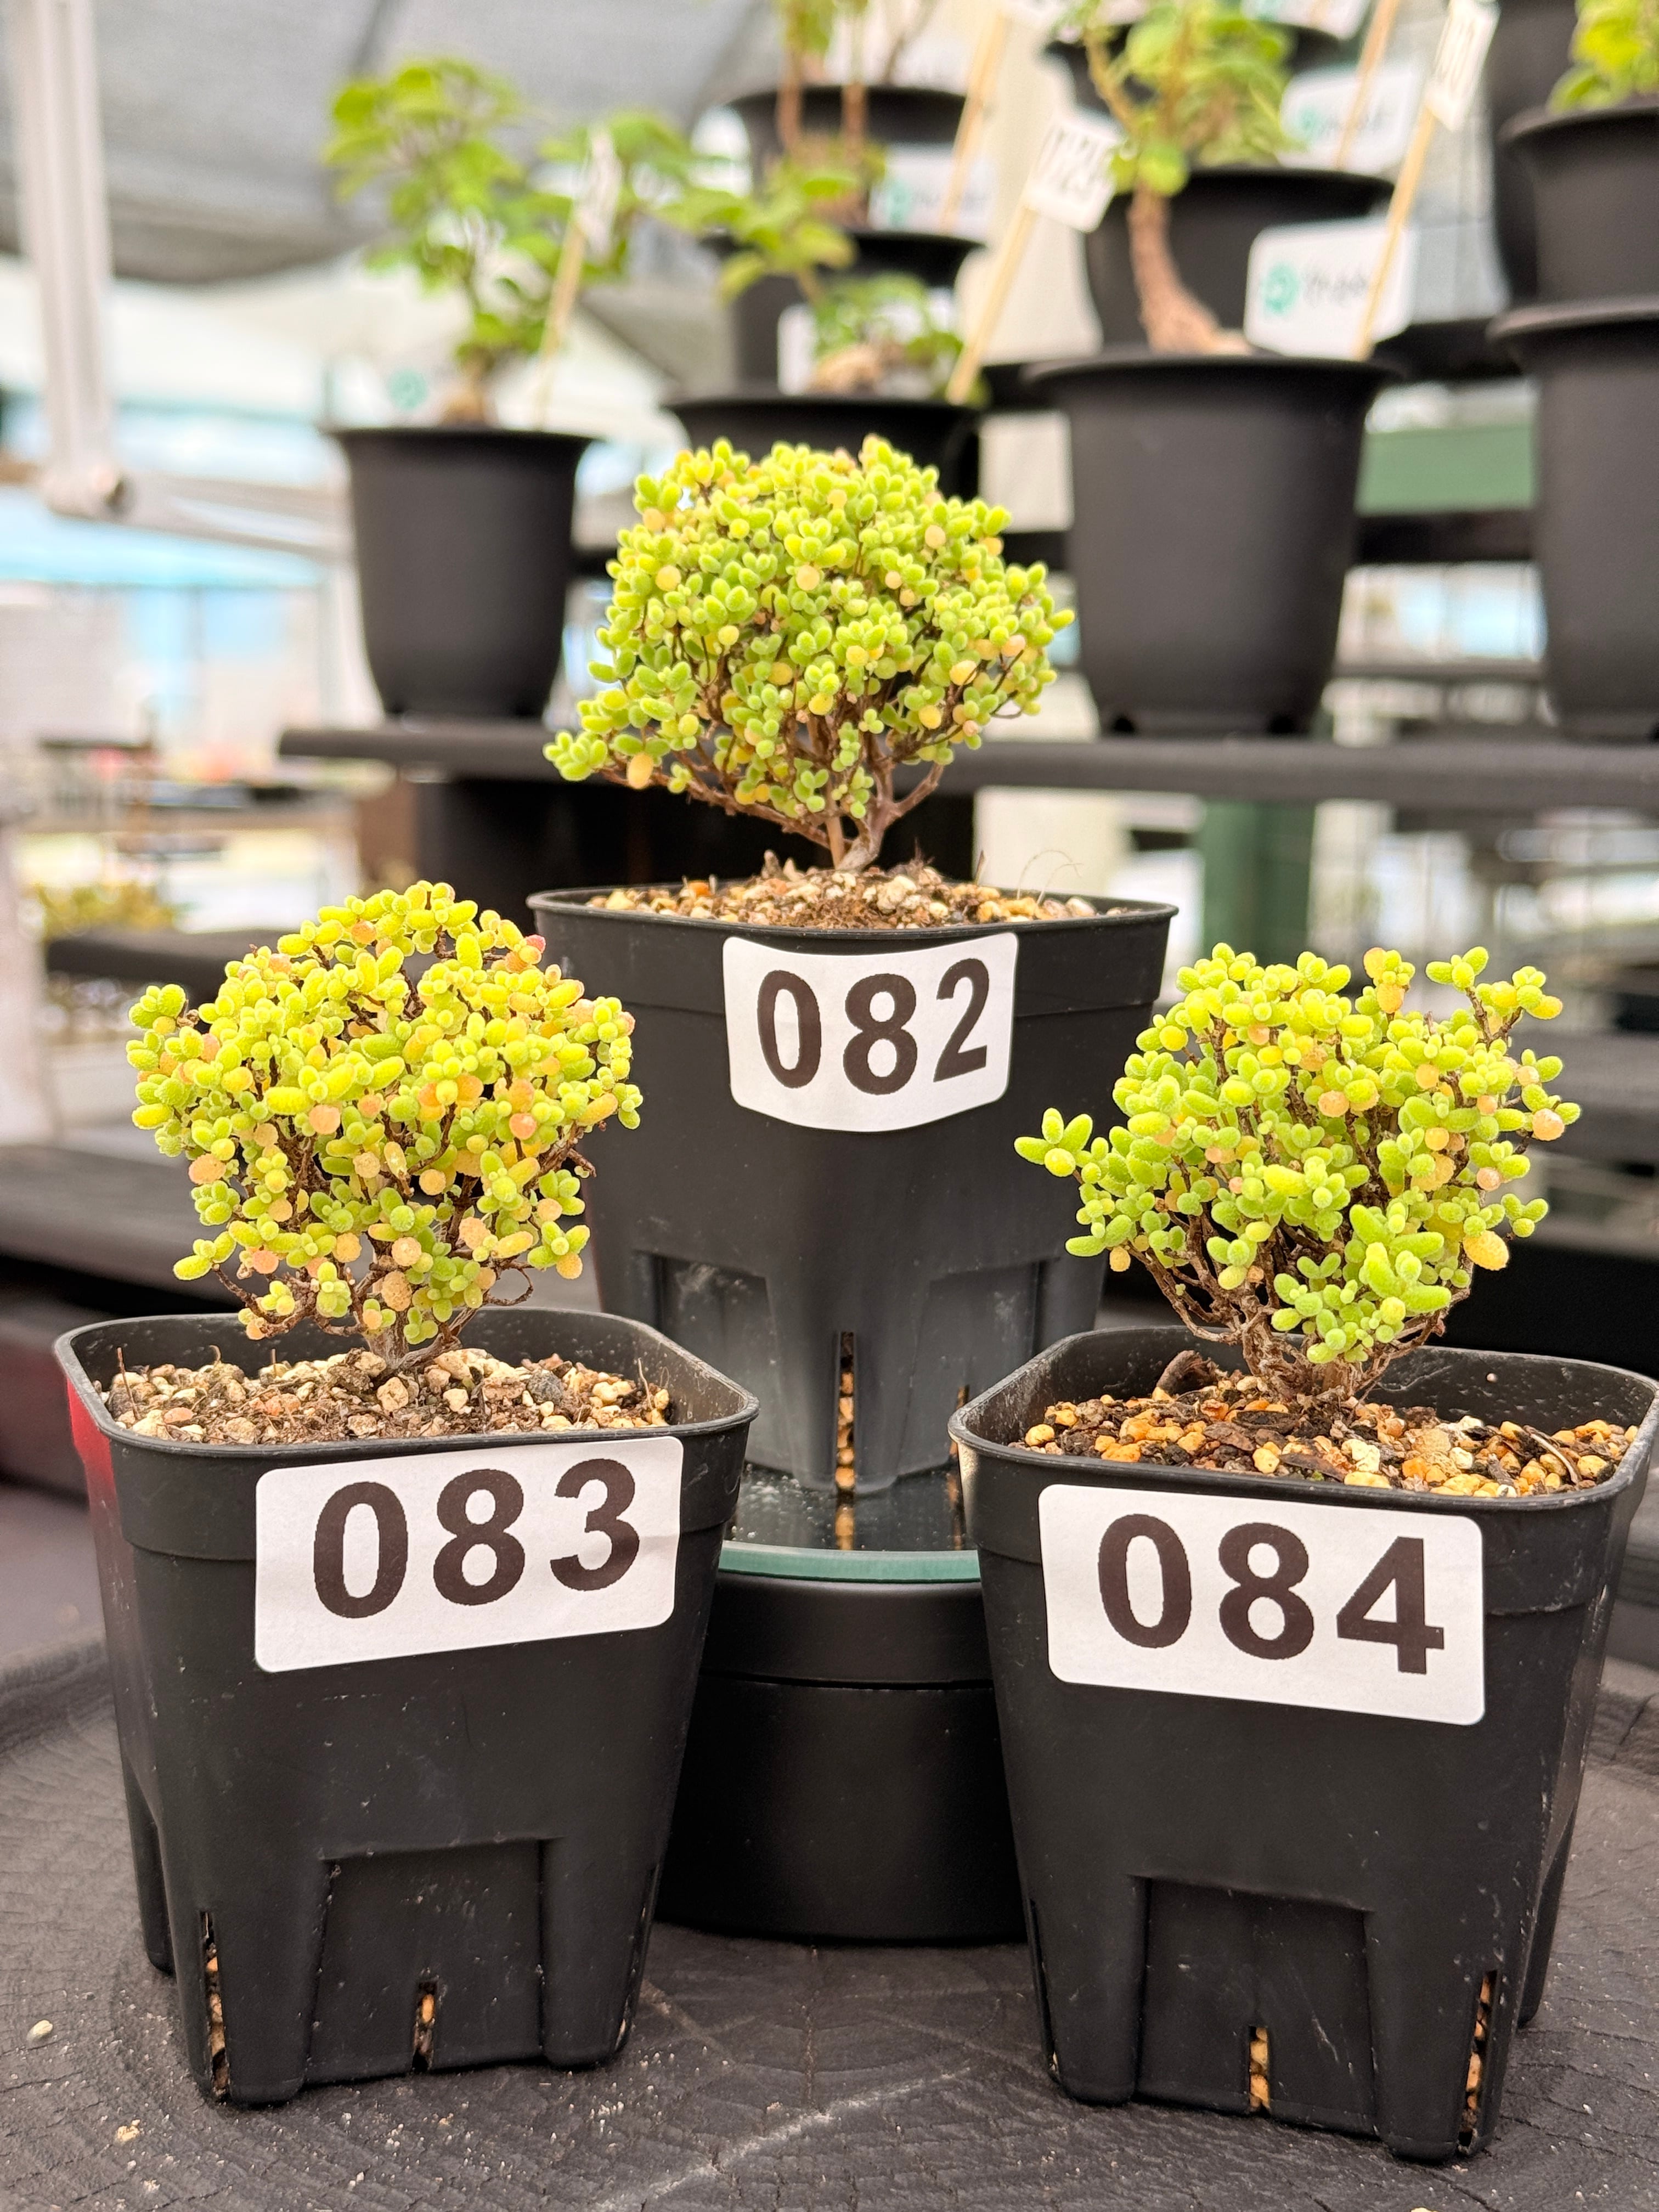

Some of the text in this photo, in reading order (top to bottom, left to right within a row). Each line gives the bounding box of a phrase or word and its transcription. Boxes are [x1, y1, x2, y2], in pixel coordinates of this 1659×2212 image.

[757, 957, 990, 1096] 082
[313, 1458, 640, 1620] 083
[1098, 1513, 1445, 1675] 084
